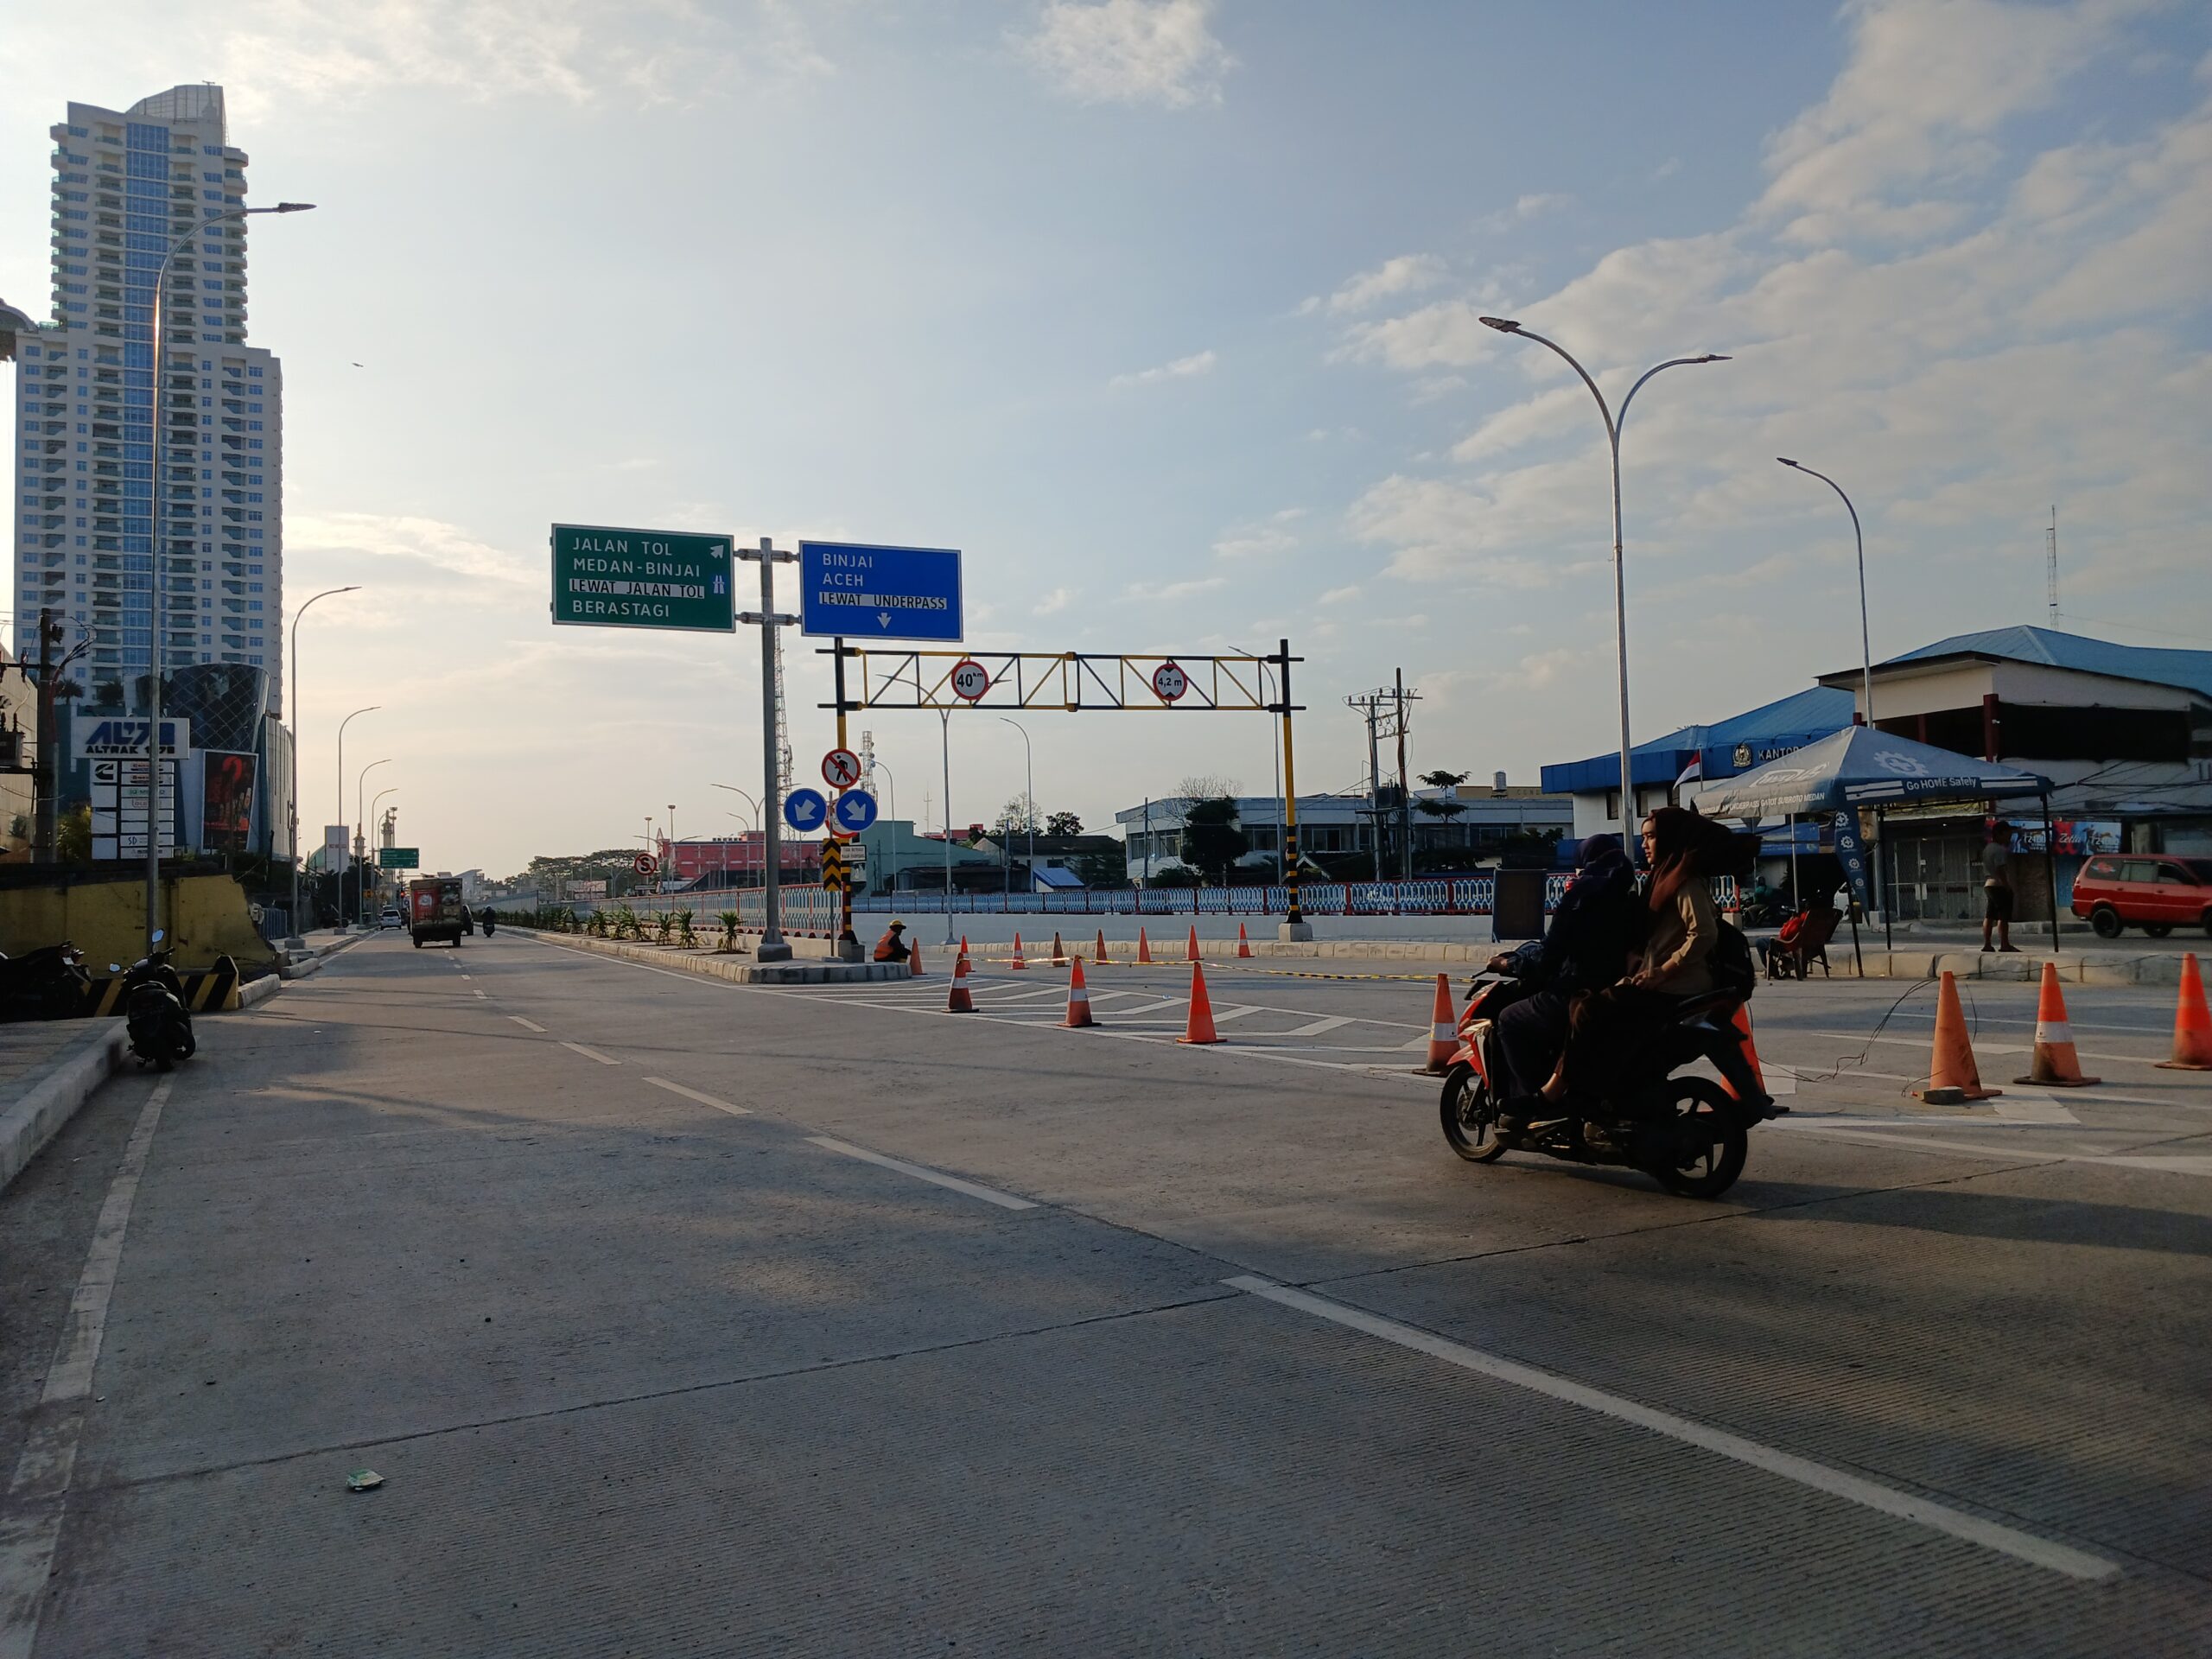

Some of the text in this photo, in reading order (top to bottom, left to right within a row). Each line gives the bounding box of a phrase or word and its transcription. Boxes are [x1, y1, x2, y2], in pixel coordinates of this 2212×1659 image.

[573, 537, 672, 556] JALAN TOL
[573, 558, 700, 577] MEDAN-BINJAI
[823, 553, 873, 568] BINJAI
[823, 573, 863, 587] ACEH
[571, 580, 703, 598] LEWAT JALAN TOL
[573, 601, 669, 617] BERASTAGI
[822, 593, 944, 609] LEWAT UNDERPASS
[957, 674, 973, 687] 40
[1158, 677, 1172, 688] 4,2
[1906, 777, 1976, 791] Go HOME Safely
[1729, 800, 1759, 810] UNDERPASS
[1760, 798, 1777, 807] GATOT
[1777, 794, 1802, 805] SUBROTO
[1804, 791, 1825, 803] MEDAN
